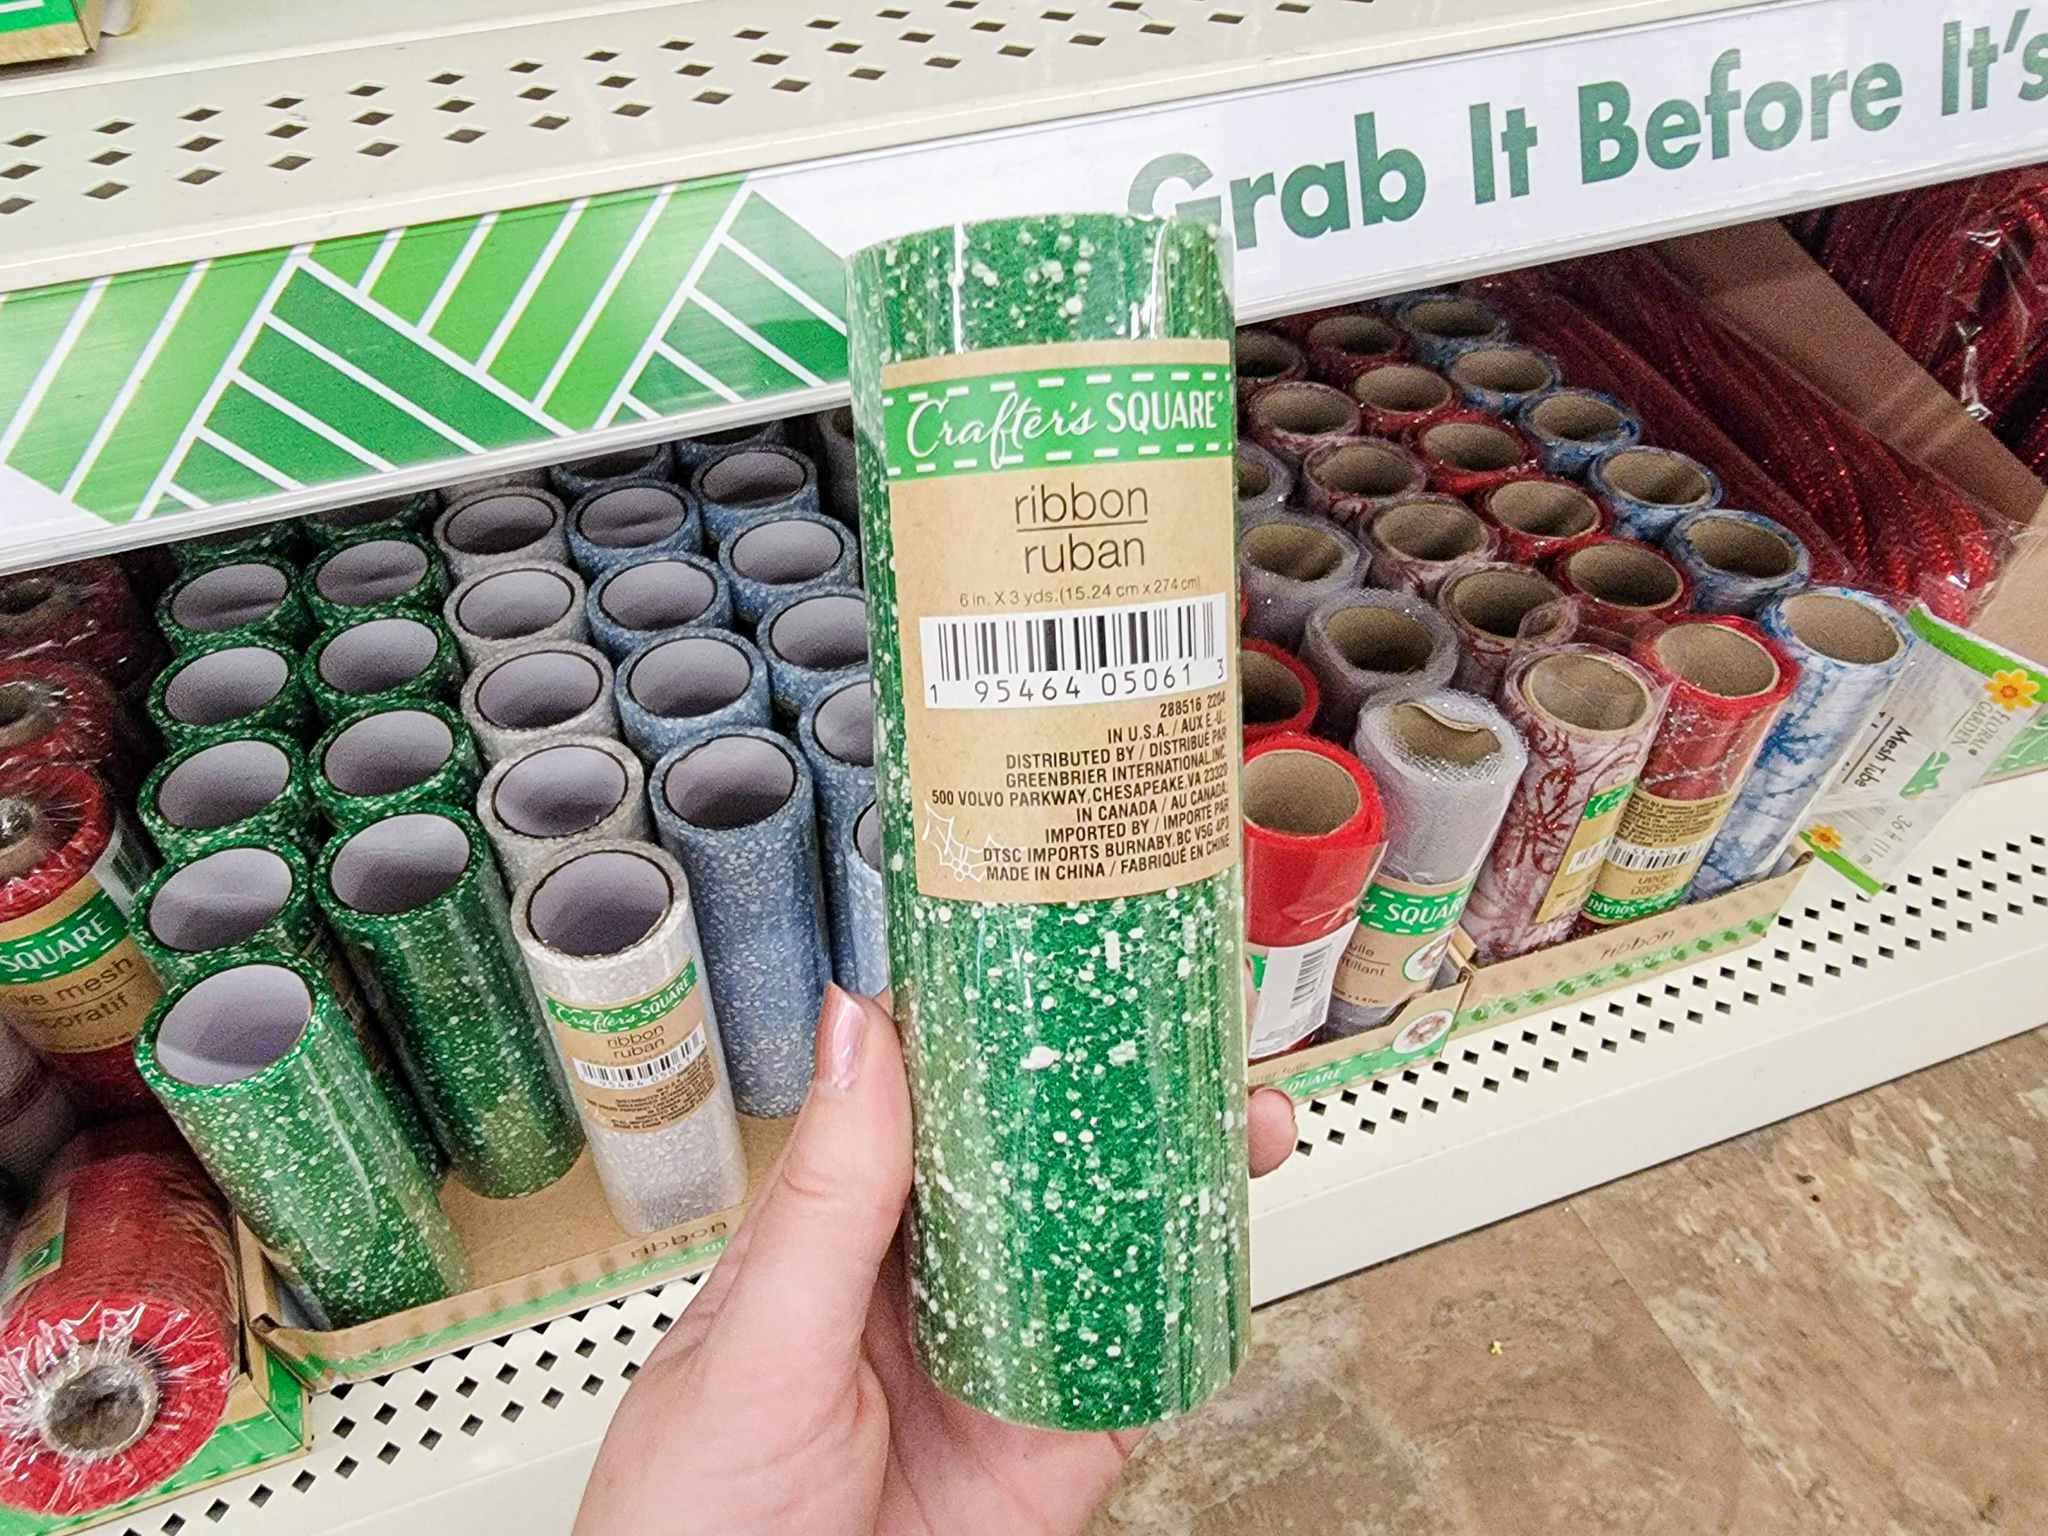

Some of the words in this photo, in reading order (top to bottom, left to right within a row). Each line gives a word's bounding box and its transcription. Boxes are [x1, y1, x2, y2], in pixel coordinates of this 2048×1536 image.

[1128, 113, 1426, 251] Grab
[1469, 102, 1537, 203] It
[1578, 49, 1902, 185] Before
[907, 392, 1097, 469] Crafter's
[1105, 391, 1217, 436] SQUARE
[1015, 482, 1148, 524] ribbon
[1024, 533, 1145, 574] ruban
[960, 592, 968, 607] 6
[1012, 590, 1019, 605] 3
[1116, 584, 1137, 597] cm
[1154, 577, 1178, 593] 274
[974, 676, 1080, 703] 95464
[1101, 664, 1192, 696] 05061
[1217, 658, 1225, 679] 3
[1159, 697, 1201, 718] 288516
[1107, 727, 1122, 744] IN
[1128, 722, 1169, 742] U.S.A.
[1181, 714, 1204, 733] AUX
[1874, 725, 1913, 763] Mesh
[1006, 748, 1110, 769] DISTRIBUTED
[1116, 745, 1135, 762] BY
[1854, 763, 1887, 788] Tube
[1006, 768, 1107, 788] GREENBRIER
[931, 789, 954, 805] 500
[958, 790, 1004, 806] VOLVO
[1076, 808, 1092, 823] IN
[1098, 799, 1157, 821] CANADA
[1171, 795, 1187, 810] AU
[984, 847, 1022, 863] DTSC
[1028, 844, 1100, 863] IMPORTS
[1194, 822, 1213, 841] V5G
[1045, 822, 1126, 843] IMPORTED
[1132, 819, 1150, 837] BY
[986, 866, 1029, 881] MADE
[1034, 866, 1050, 881] IN
[1056, 862, 1105, 881] CHINA
[1190, 844, 1204, 861] EN
[0, 912, 113, 972] SQUARE
[56, 957, 133, 1001] mesh
[639, 977, 690, 1016] SQUARE
[607, 1024, 665, 1048] ribbon
[613, 1038, 665, 1060] ruban
[631, 1221, 728, 1258] ribbon
